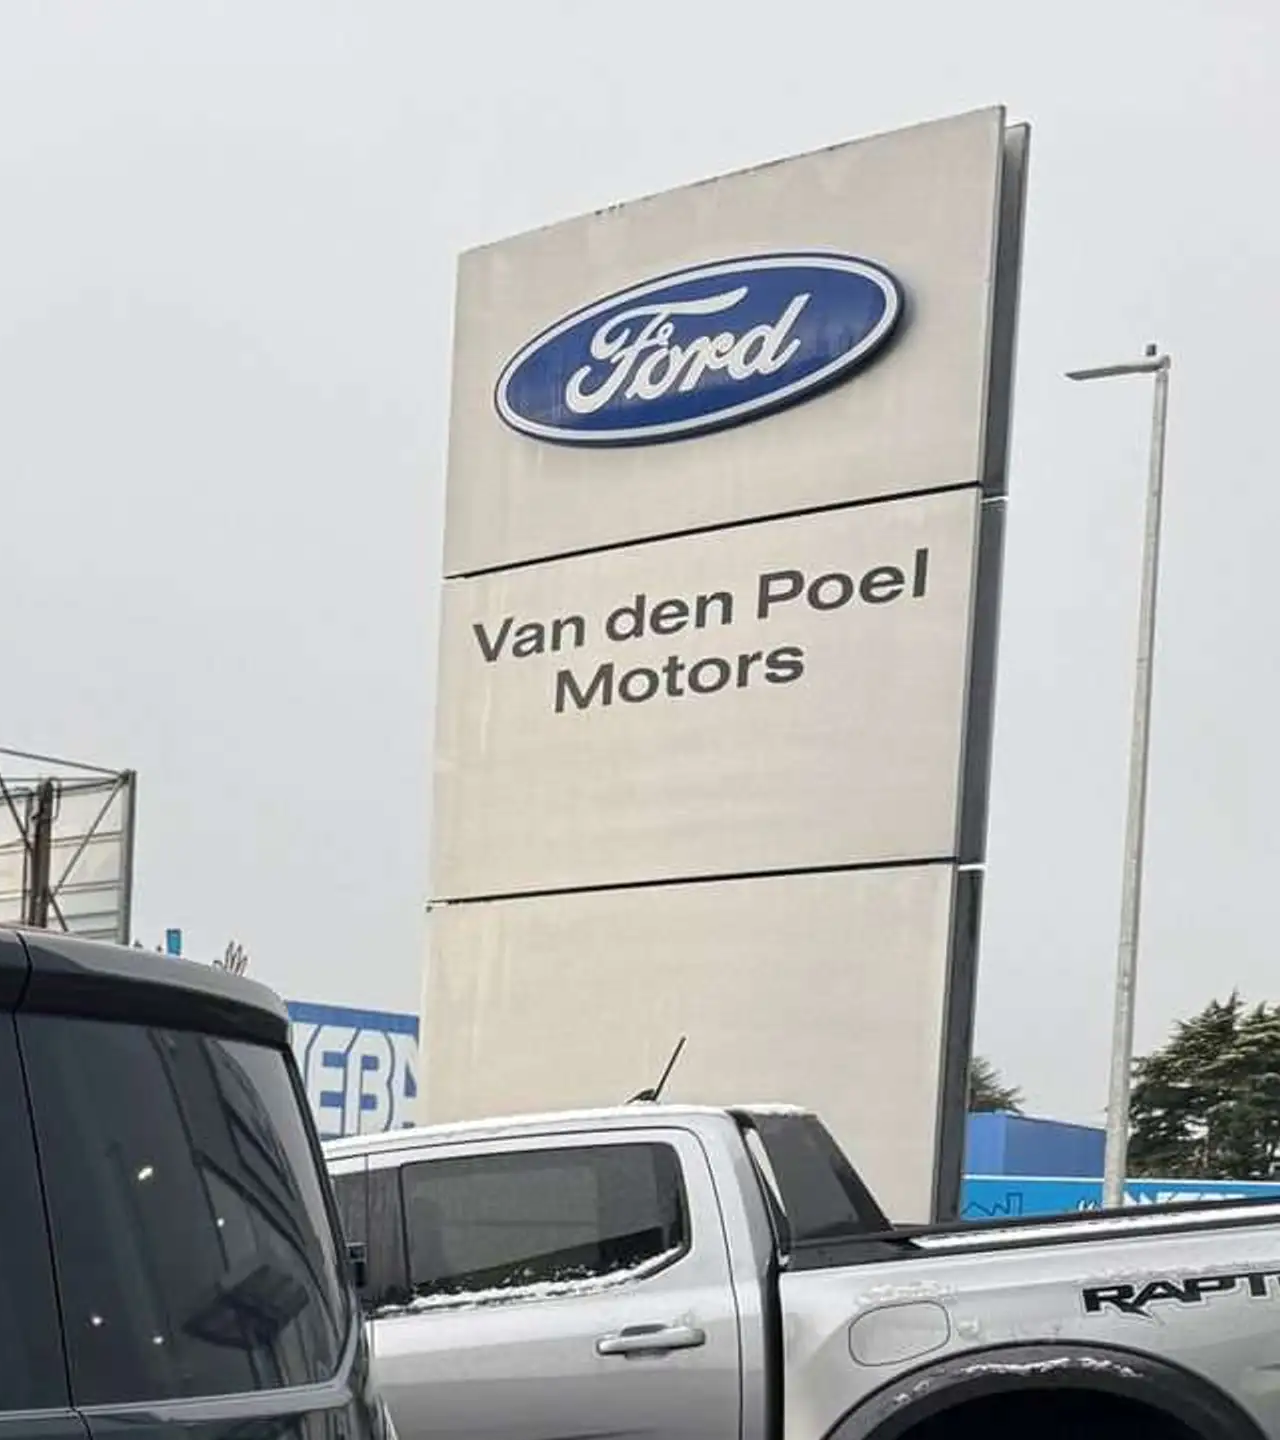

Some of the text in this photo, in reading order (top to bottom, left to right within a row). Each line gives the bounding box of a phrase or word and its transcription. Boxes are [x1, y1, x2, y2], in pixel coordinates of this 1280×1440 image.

[566, 286, 811, 414] Ford
[473, 548, 928, 663] Van den Poel
[554, 645, 805, 713] Motors
[1082, 1270, 1280, 1317] RAPT
